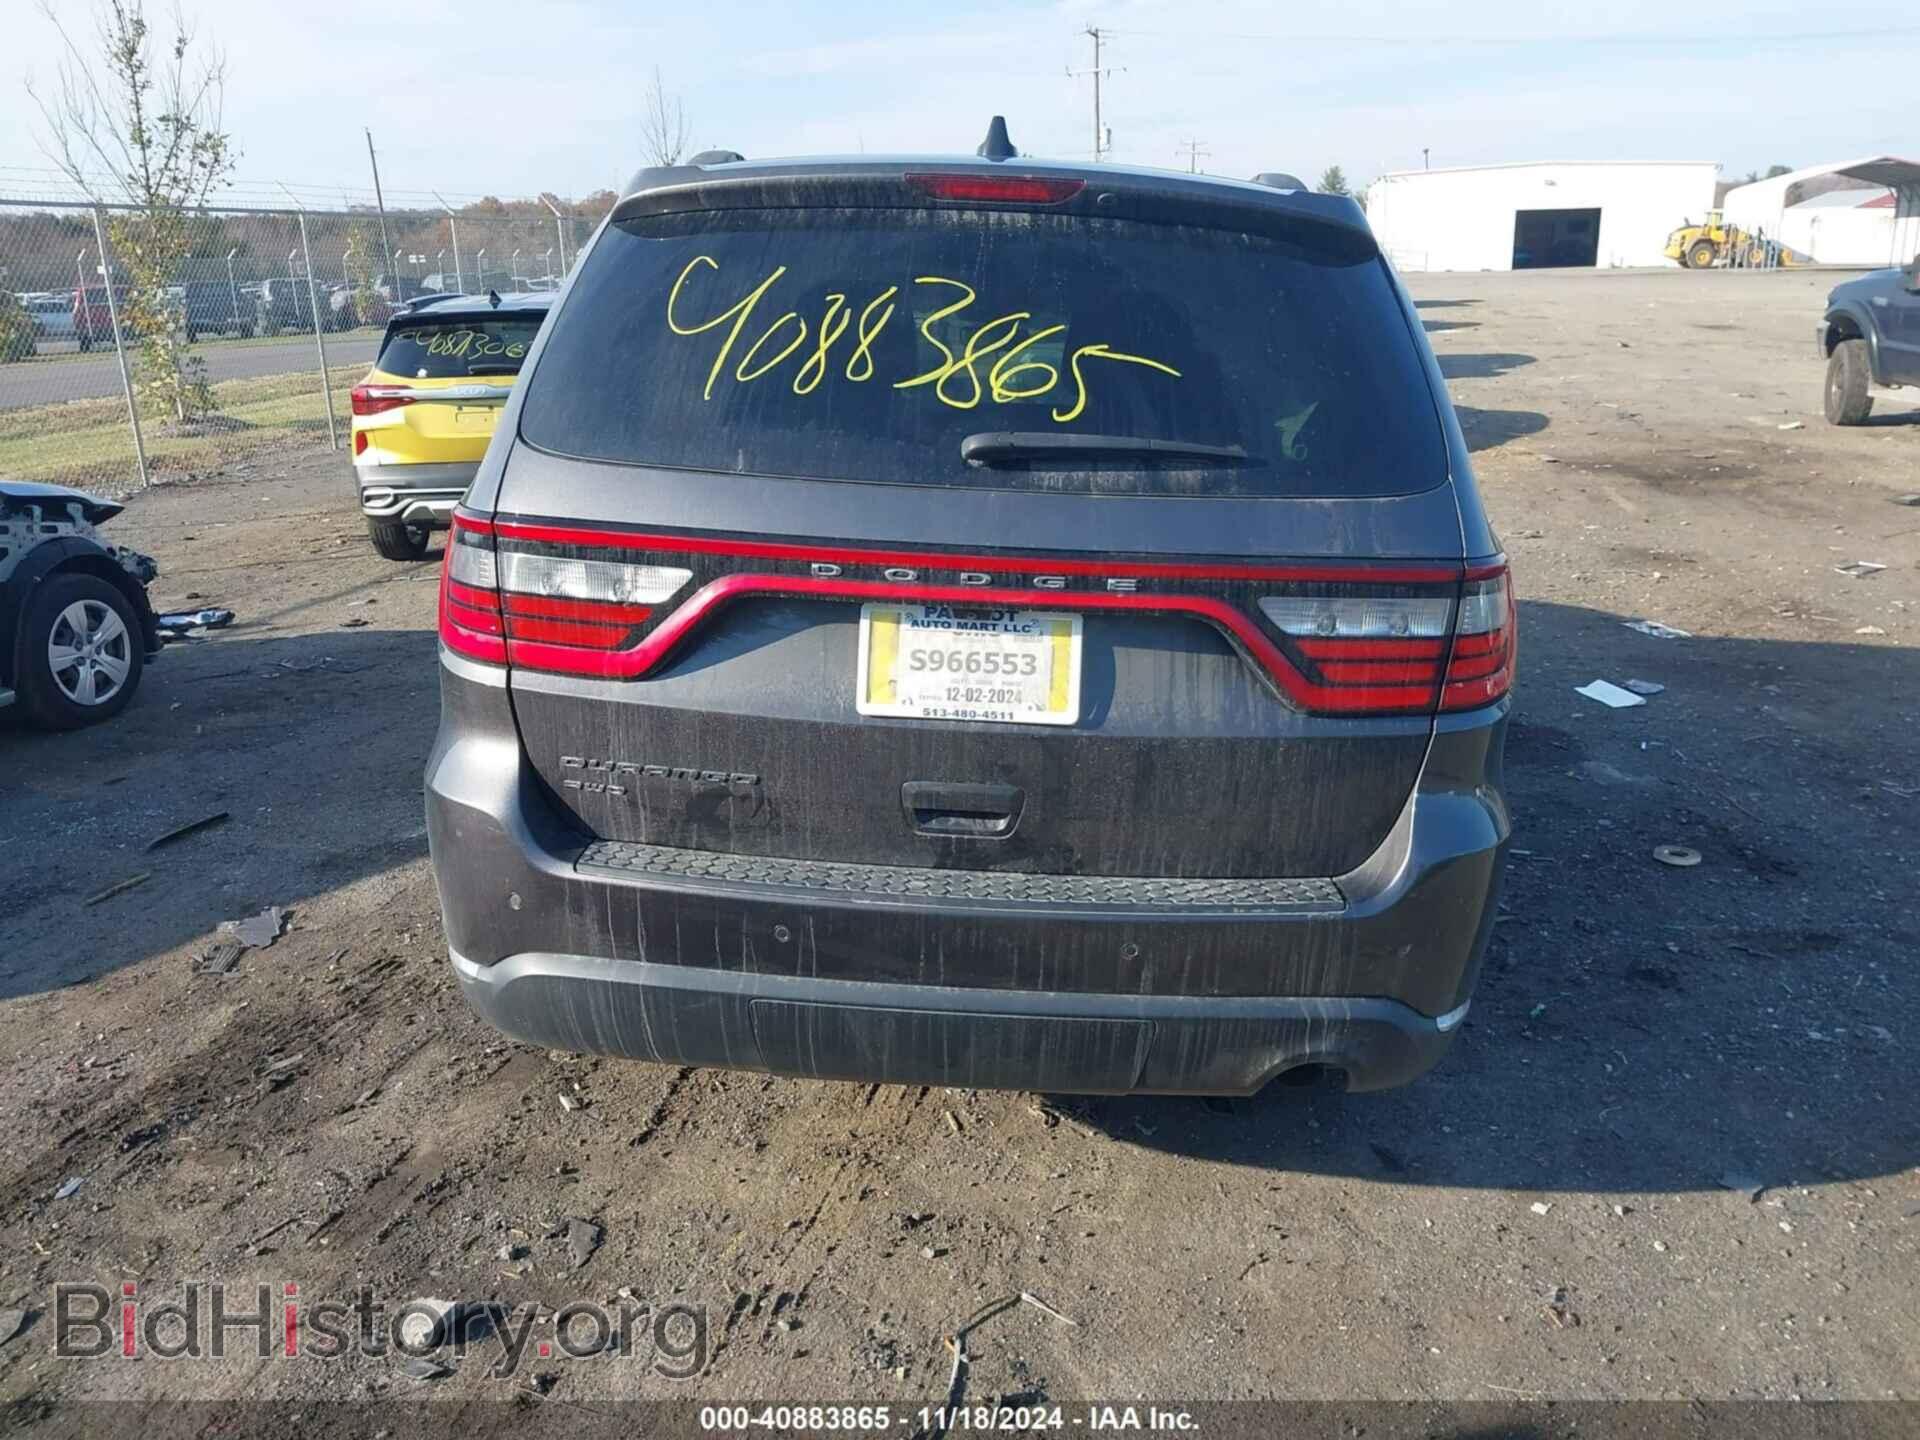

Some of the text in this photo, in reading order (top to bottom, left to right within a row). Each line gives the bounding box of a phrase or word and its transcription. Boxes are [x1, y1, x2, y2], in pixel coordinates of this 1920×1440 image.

[668, 255, 1182, 422] 40883865
[810, 562, 1138, 592] DODGE
[911, 618, 1033, 634] AUTO MART LLC
[909, 648, 1038, 676] S966553
[945, 687, 1023, 705] 12-02-2024
[922, 707, 1015, 721] 513-480-4511
[559, 755, 760, 786] DURANGO
